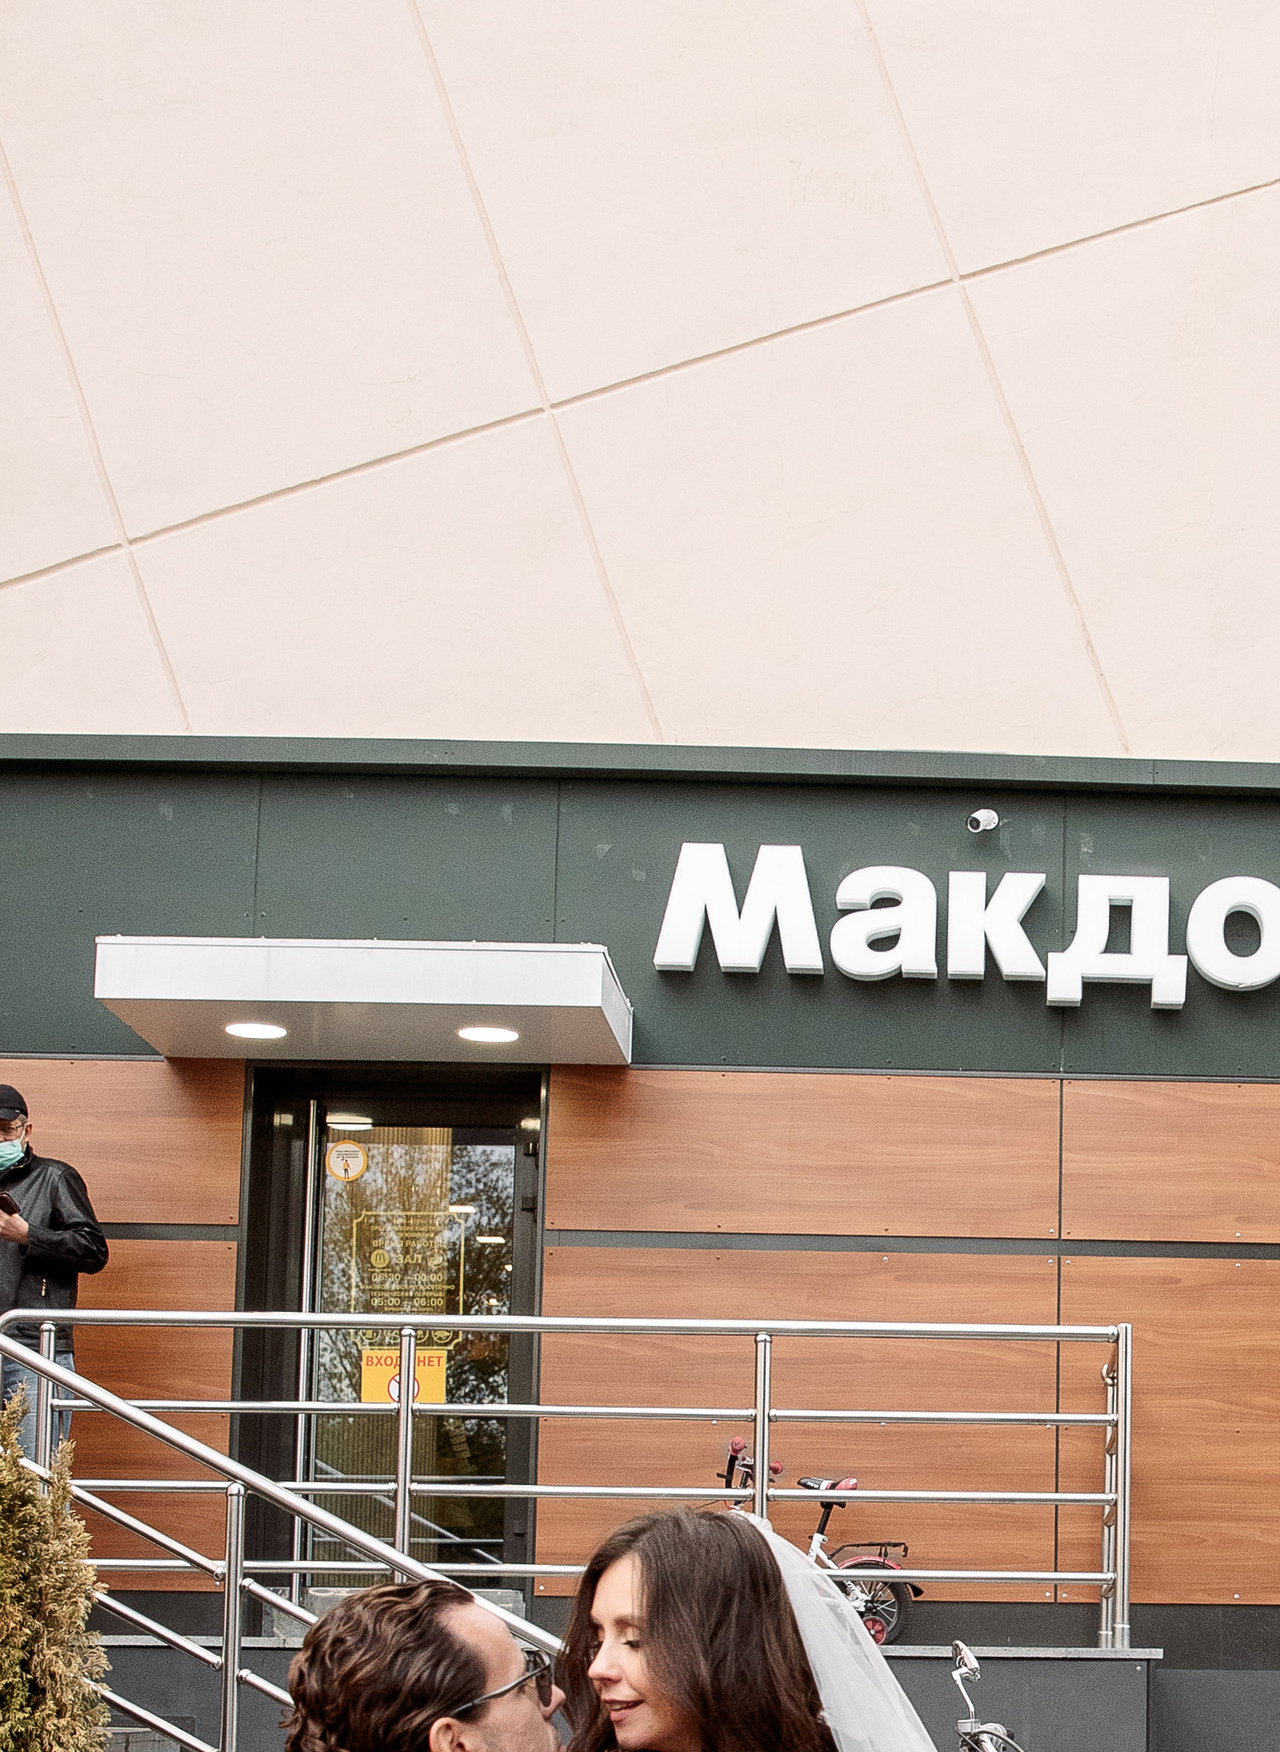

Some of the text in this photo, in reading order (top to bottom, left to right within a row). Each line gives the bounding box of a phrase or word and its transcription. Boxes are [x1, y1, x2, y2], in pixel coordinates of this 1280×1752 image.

[396, 1254, 423, 1265] ЗАЛ
[371, 1273, 443, 1282] 06:30 00:00
[371, 1298, 444, 1306] 05:00 06:00
[366, 1355, 444, 1369] ВХОД НЕТ
